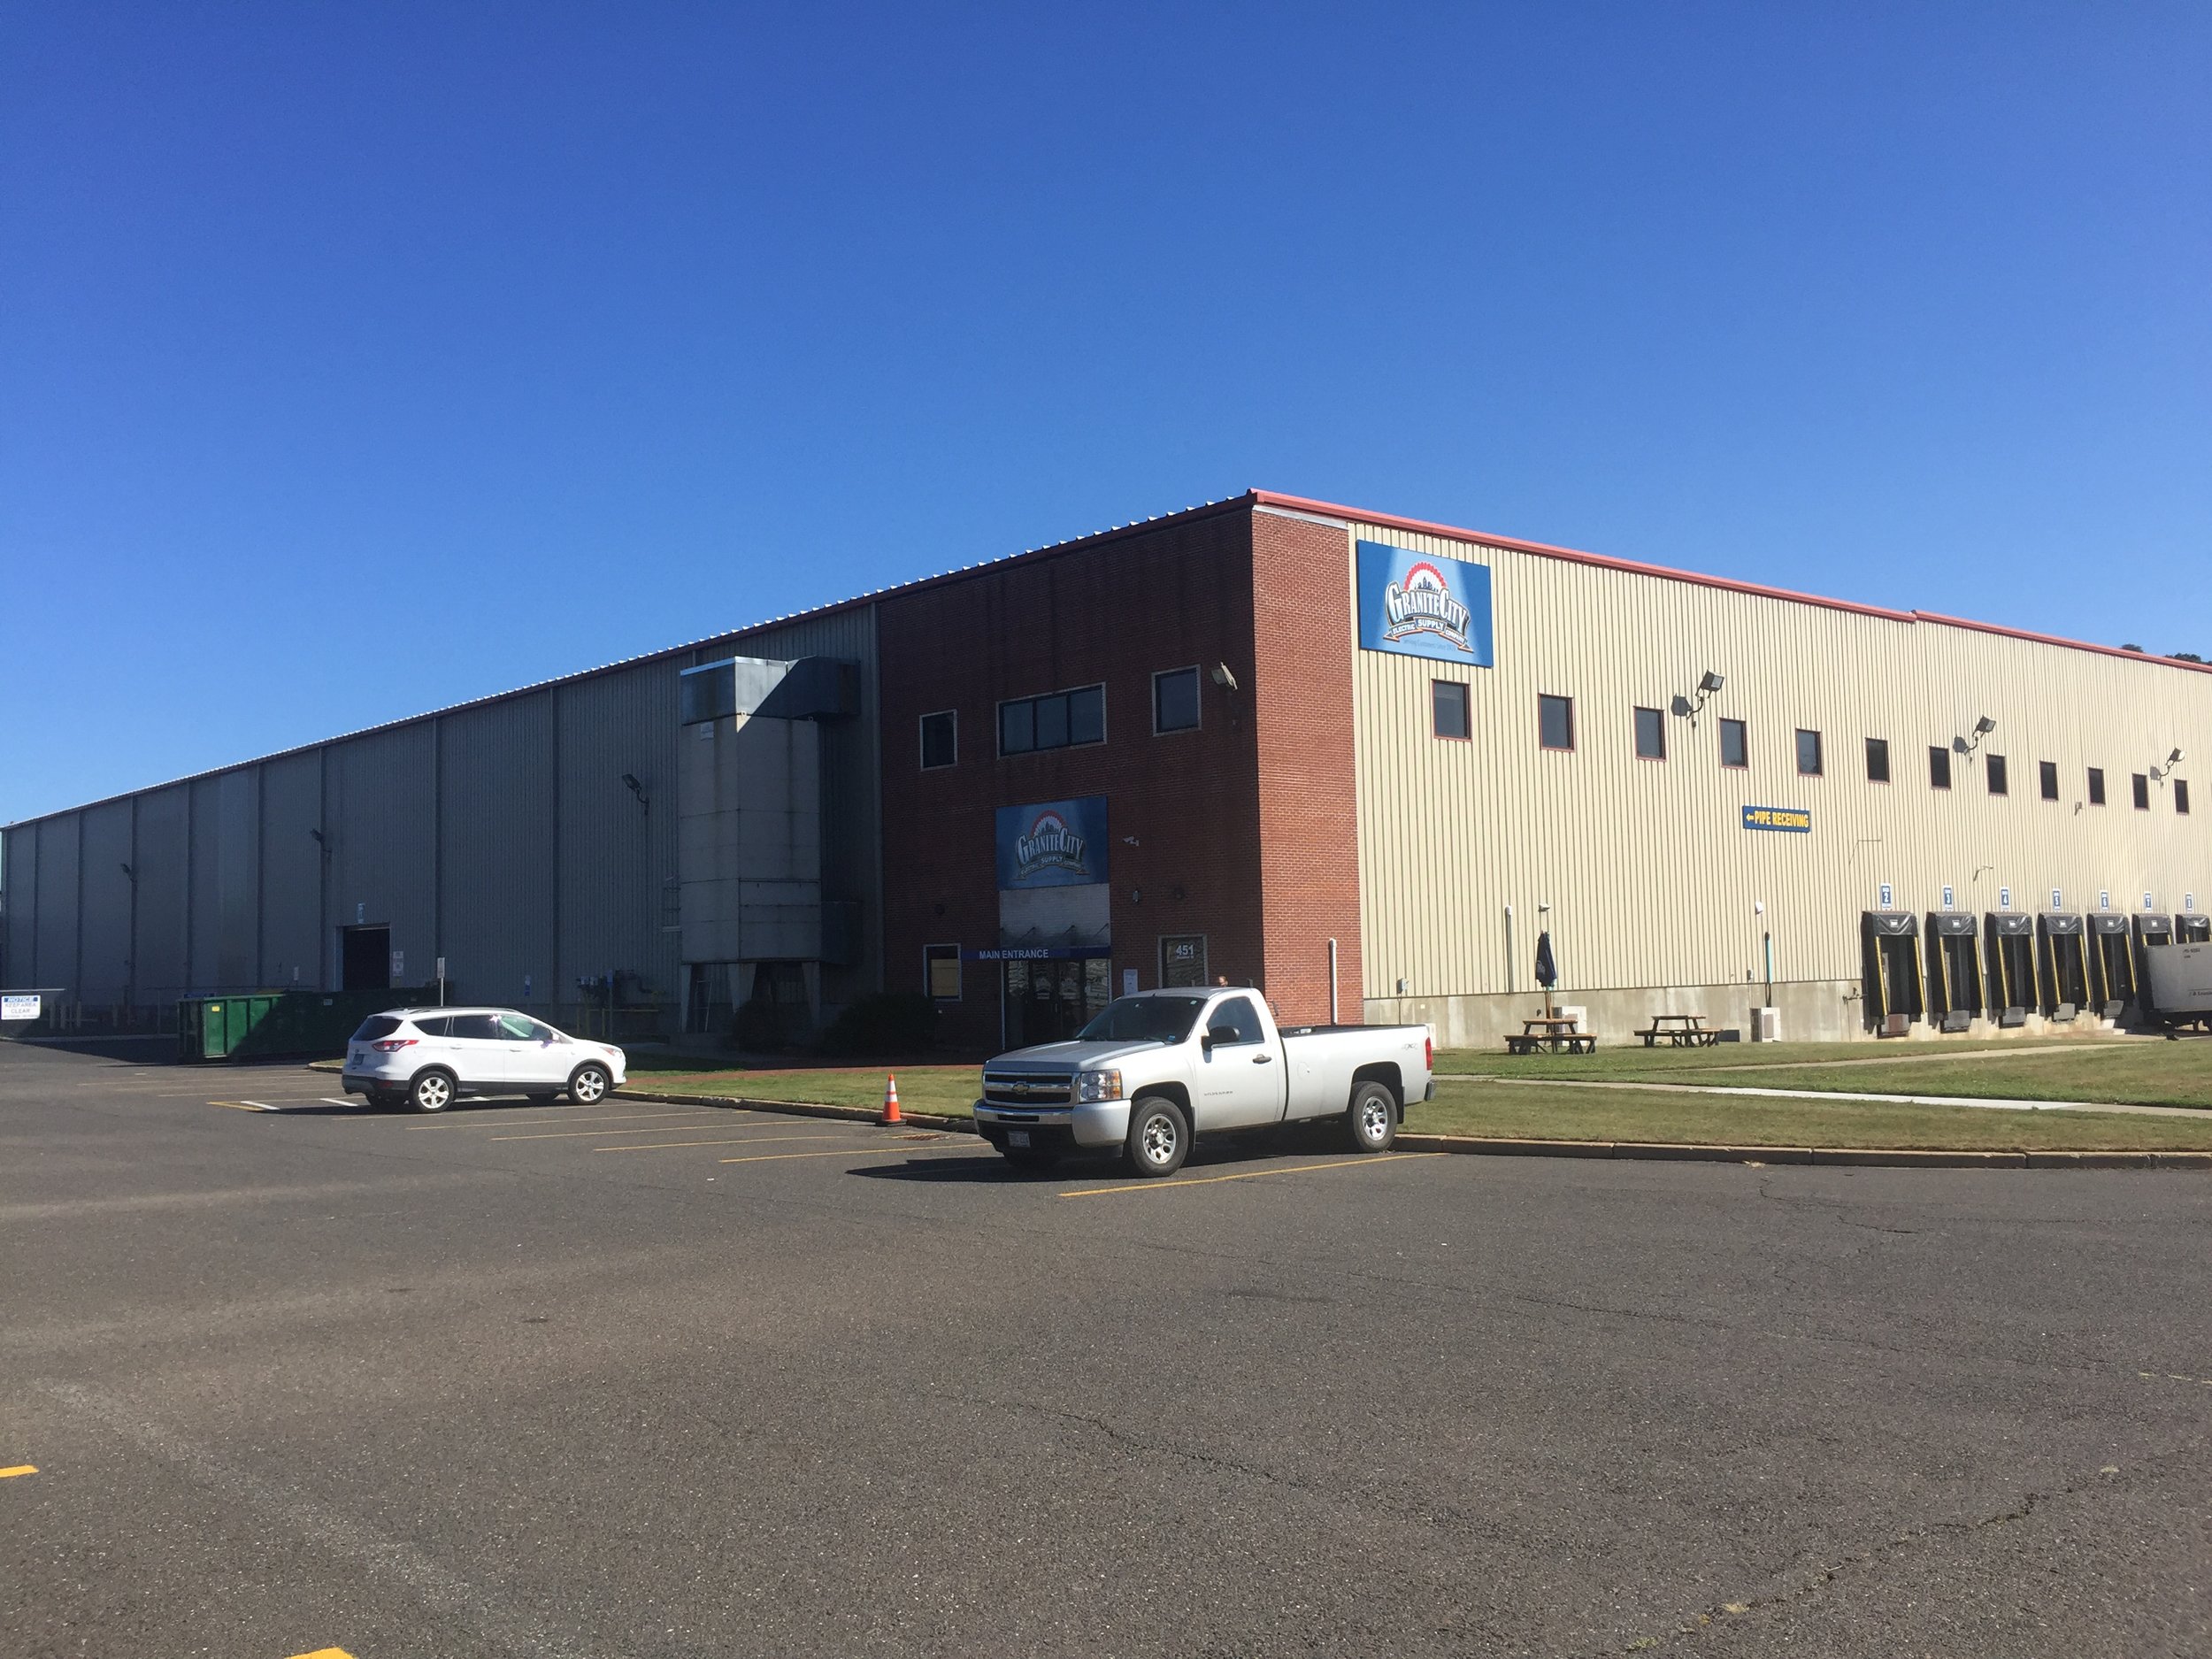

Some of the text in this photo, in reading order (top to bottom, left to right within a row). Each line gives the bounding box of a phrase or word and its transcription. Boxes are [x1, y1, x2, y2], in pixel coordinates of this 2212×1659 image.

[1417, 618, 1444, 630] SUPPLY
[1755, 810, 1809, 827] PIPE RECEIVING
[979, 949, 1049, 960] MAIN ENTRANCE
[1175, 944, 1194, 956] 451
